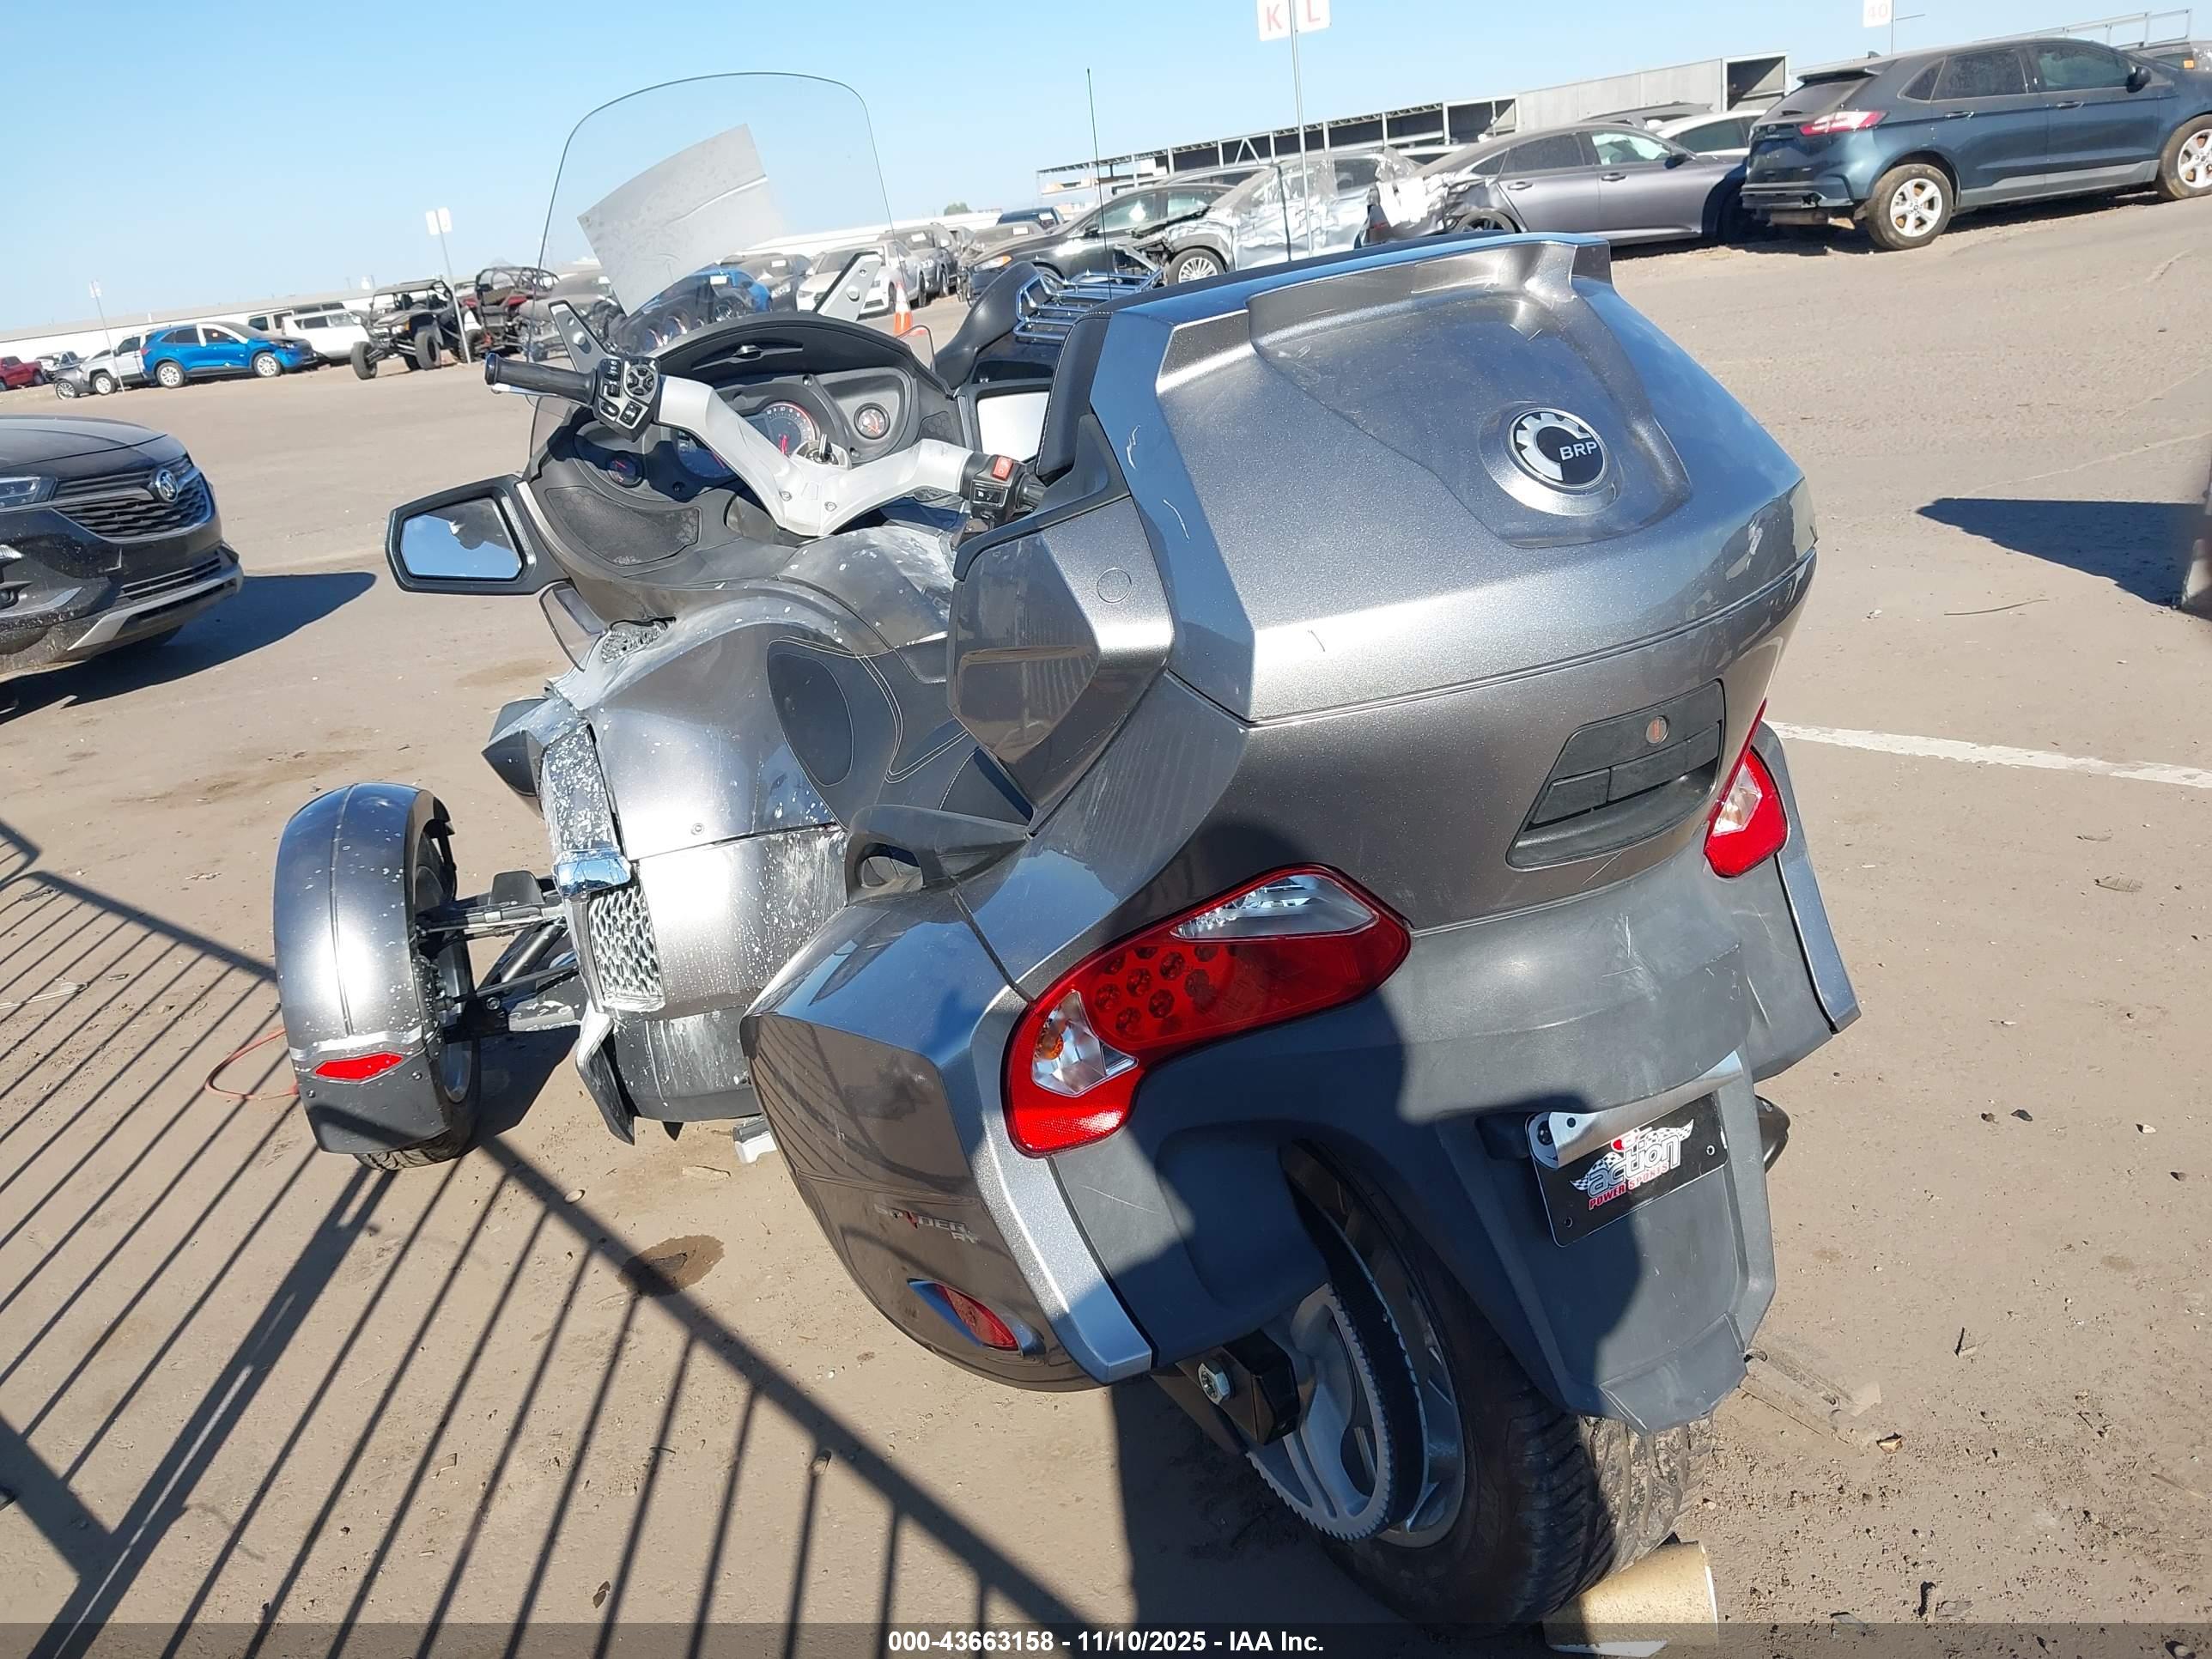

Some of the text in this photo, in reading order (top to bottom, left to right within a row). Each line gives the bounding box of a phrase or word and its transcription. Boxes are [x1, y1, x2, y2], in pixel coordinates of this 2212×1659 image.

[1267, 4, 1282, 31] K
[1306, 0, 1321, 23] L
[1869, 3, 1888, 19] 40
[1559, 441, 1598, 460] BRP
[1587, 1134, 1681, 1198] action
[1589, 1161, 1670, 1211] POWER SPORTS
